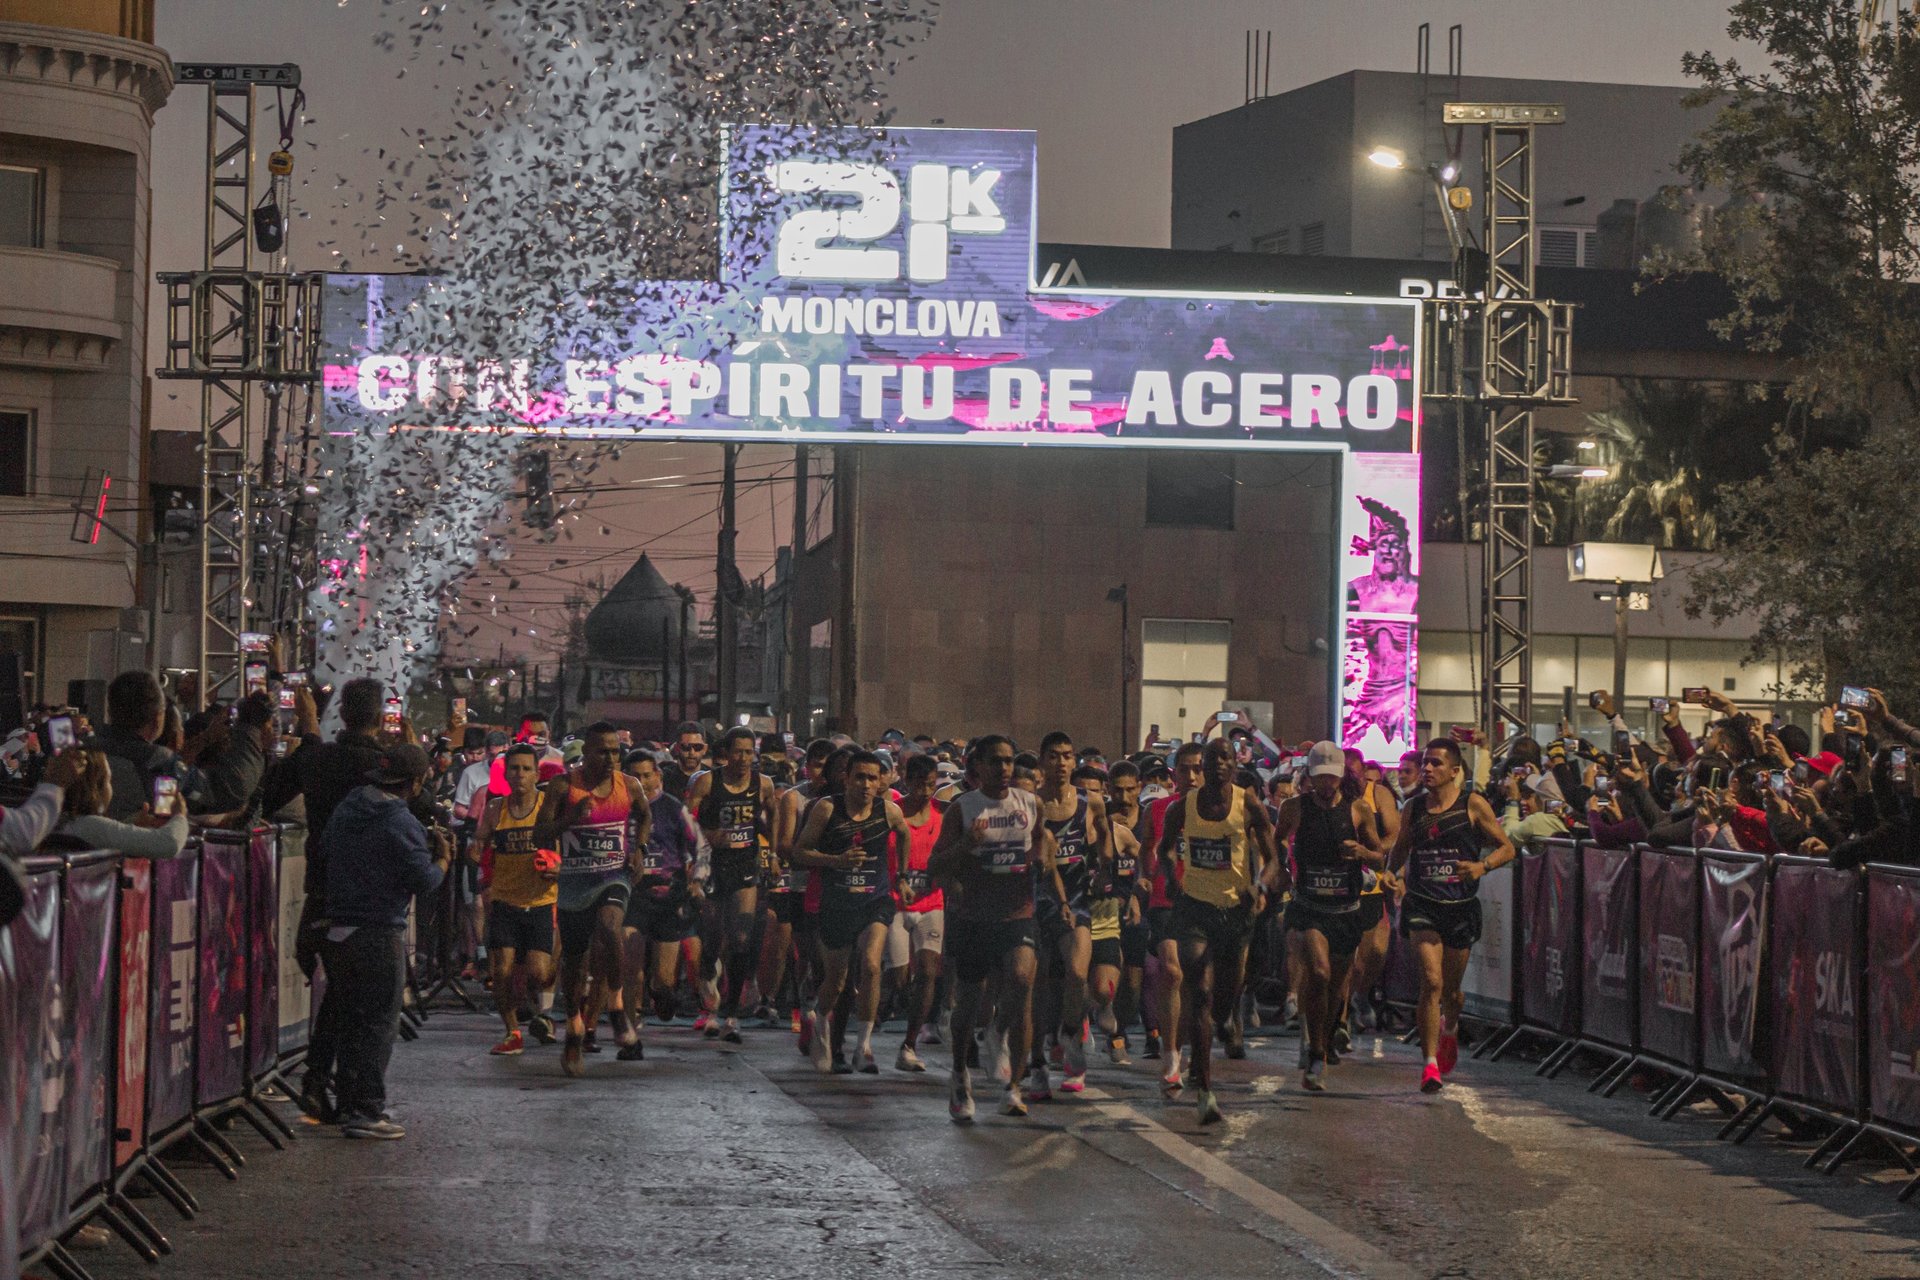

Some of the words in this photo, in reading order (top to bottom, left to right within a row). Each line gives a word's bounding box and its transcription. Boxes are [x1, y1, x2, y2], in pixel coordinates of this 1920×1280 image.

[185, 68, 286, 79] COMETA
[1456, 108, 1554, 118] COMETA
[761, 297, 1001, 337] MONCLOVA
[358, 355, 528, 411] CON
[565, 341, 954, 421] ESPÍRITU
[988, 367, 1094, 424] DE
[1125, 370, 1398, 431] ACERO
[586, 840, 614, 850] 1148
[993, 852, 1016, 864] 899
[1195, 849, 1224, 861] 1278
[1426, 865, 1454, 876] 1240
[845, 875, 866, 885] 585
[1313, 877, 1341, 888] 1017
